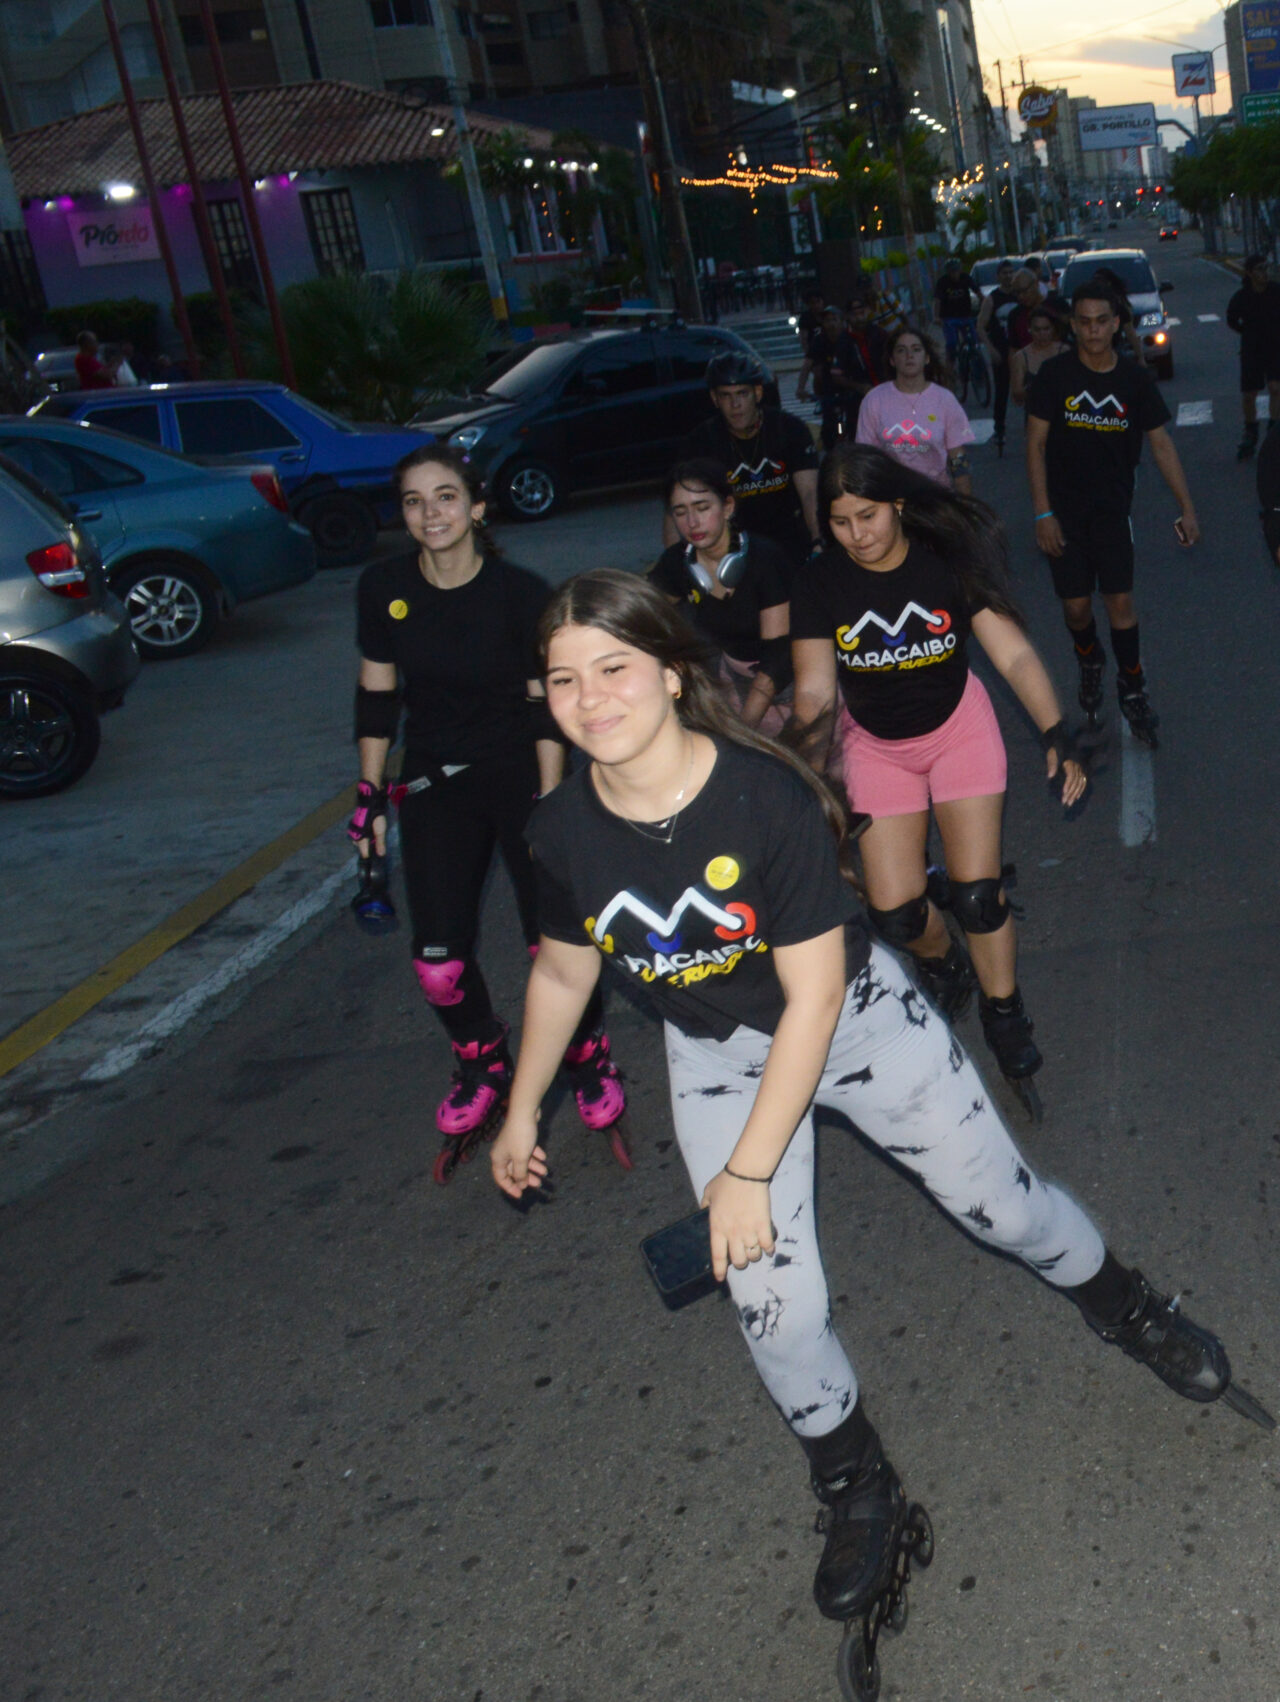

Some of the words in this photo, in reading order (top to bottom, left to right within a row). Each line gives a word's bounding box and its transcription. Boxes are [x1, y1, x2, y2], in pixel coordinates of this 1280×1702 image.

[1102, 117, 1151, 130] PORTILLO
[1064, 411, 1128, 429] MARACAIBO
[836, 633, 957, 668] MARACAIBO
